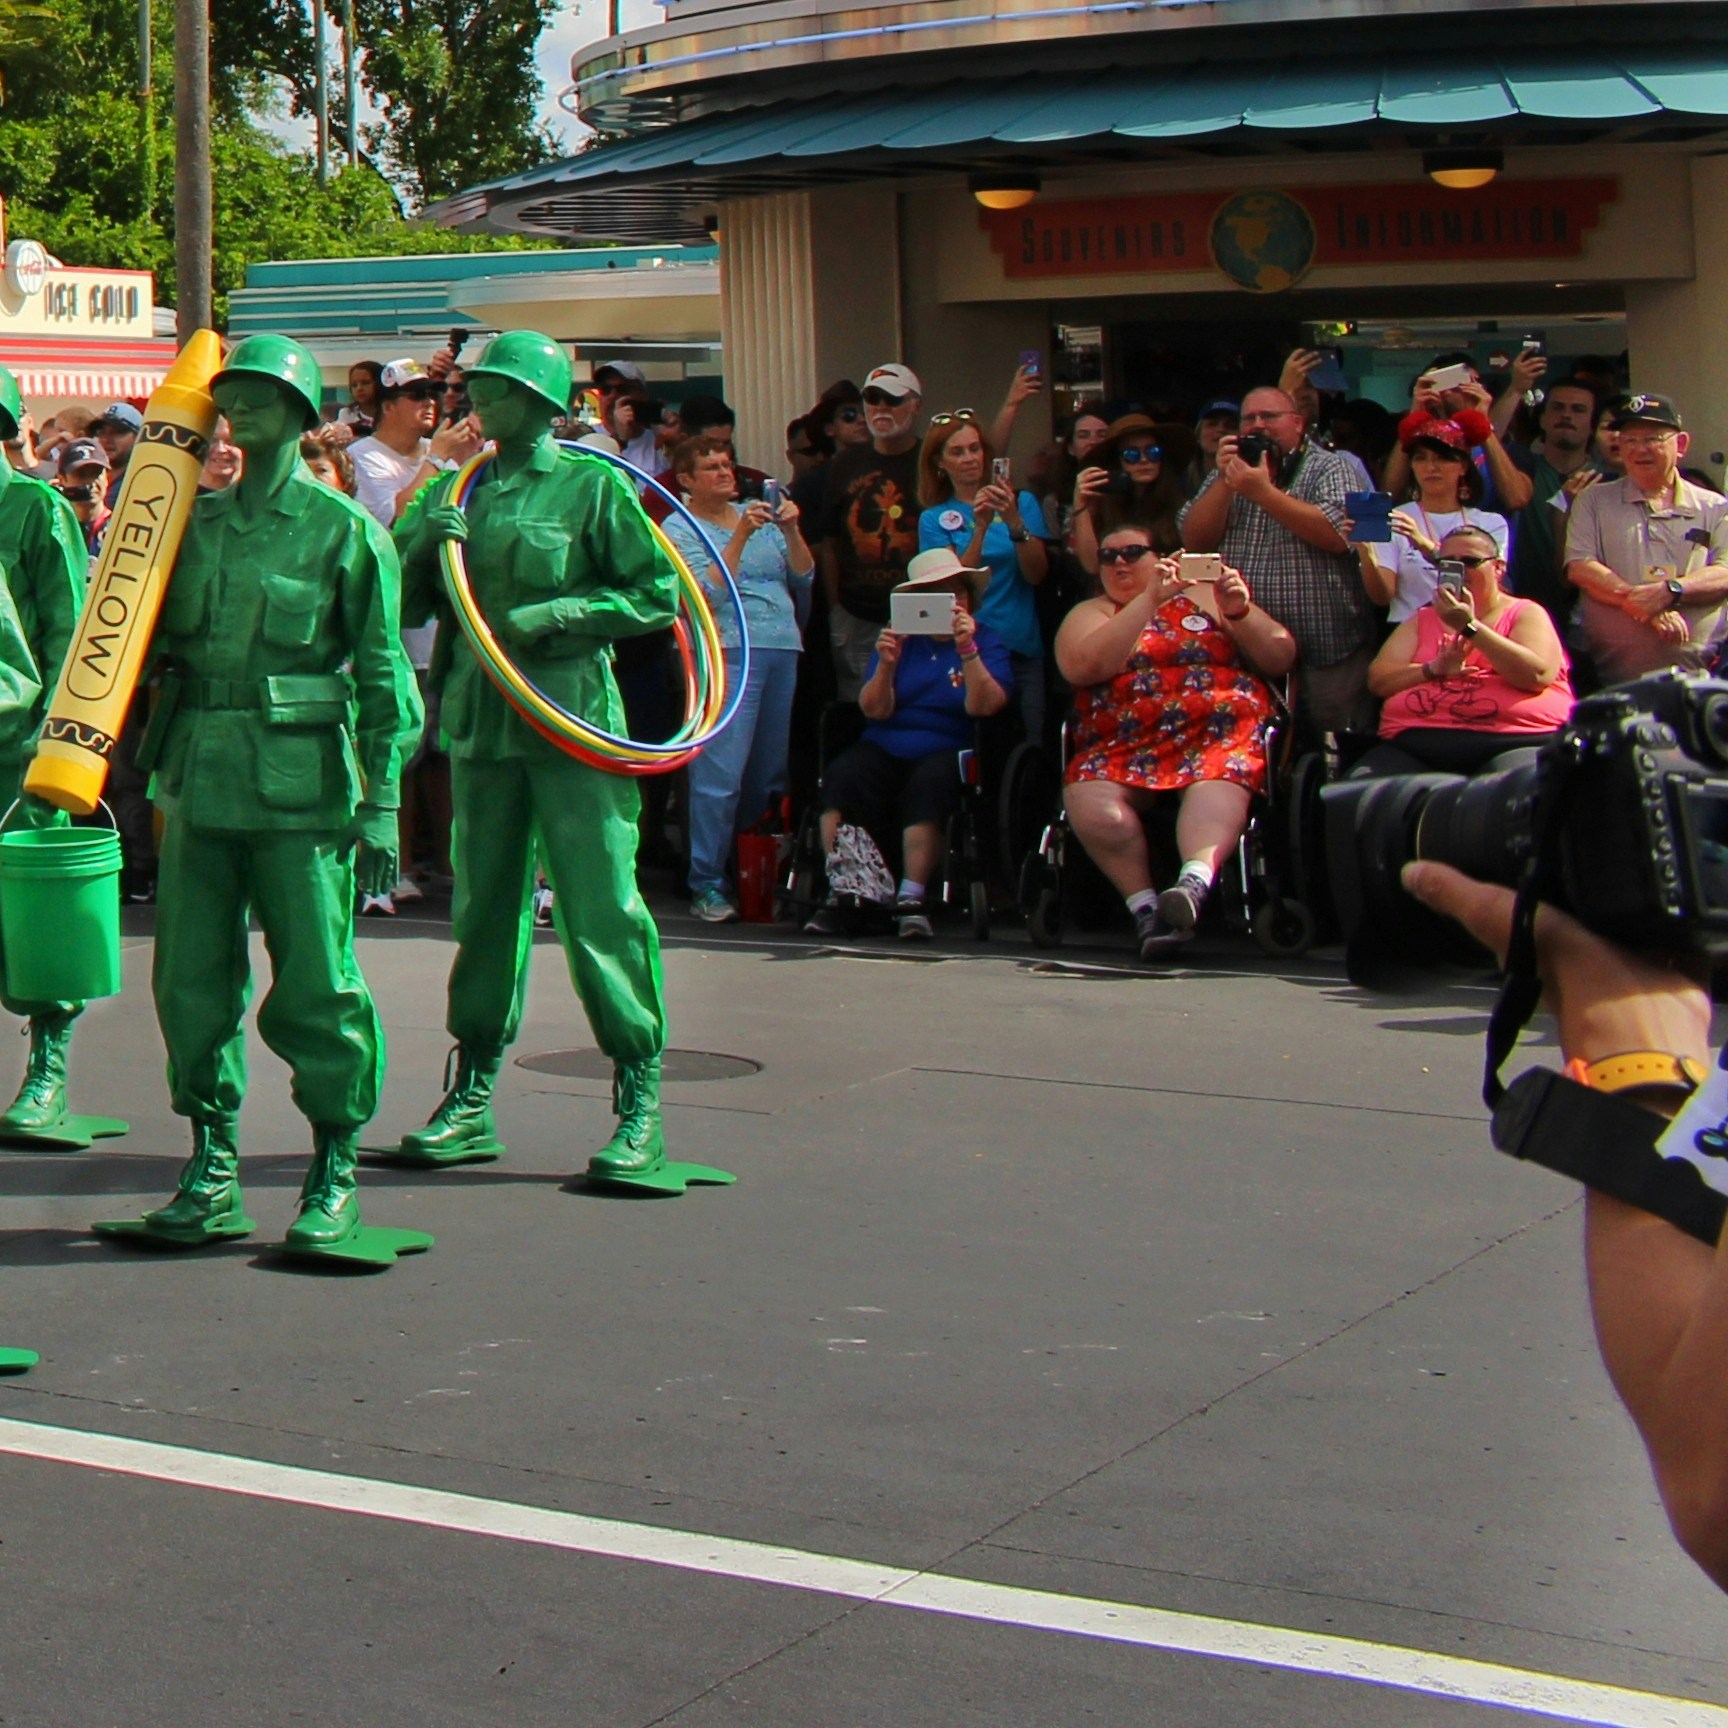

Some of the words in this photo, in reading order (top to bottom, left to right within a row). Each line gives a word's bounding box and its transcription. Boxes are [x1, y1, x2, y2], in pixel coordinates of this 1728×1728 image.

[44, 281, 80, 322] ICE
[89, 284, 139, 324] COLD
[80, 495, 165, 678] YELLOW
